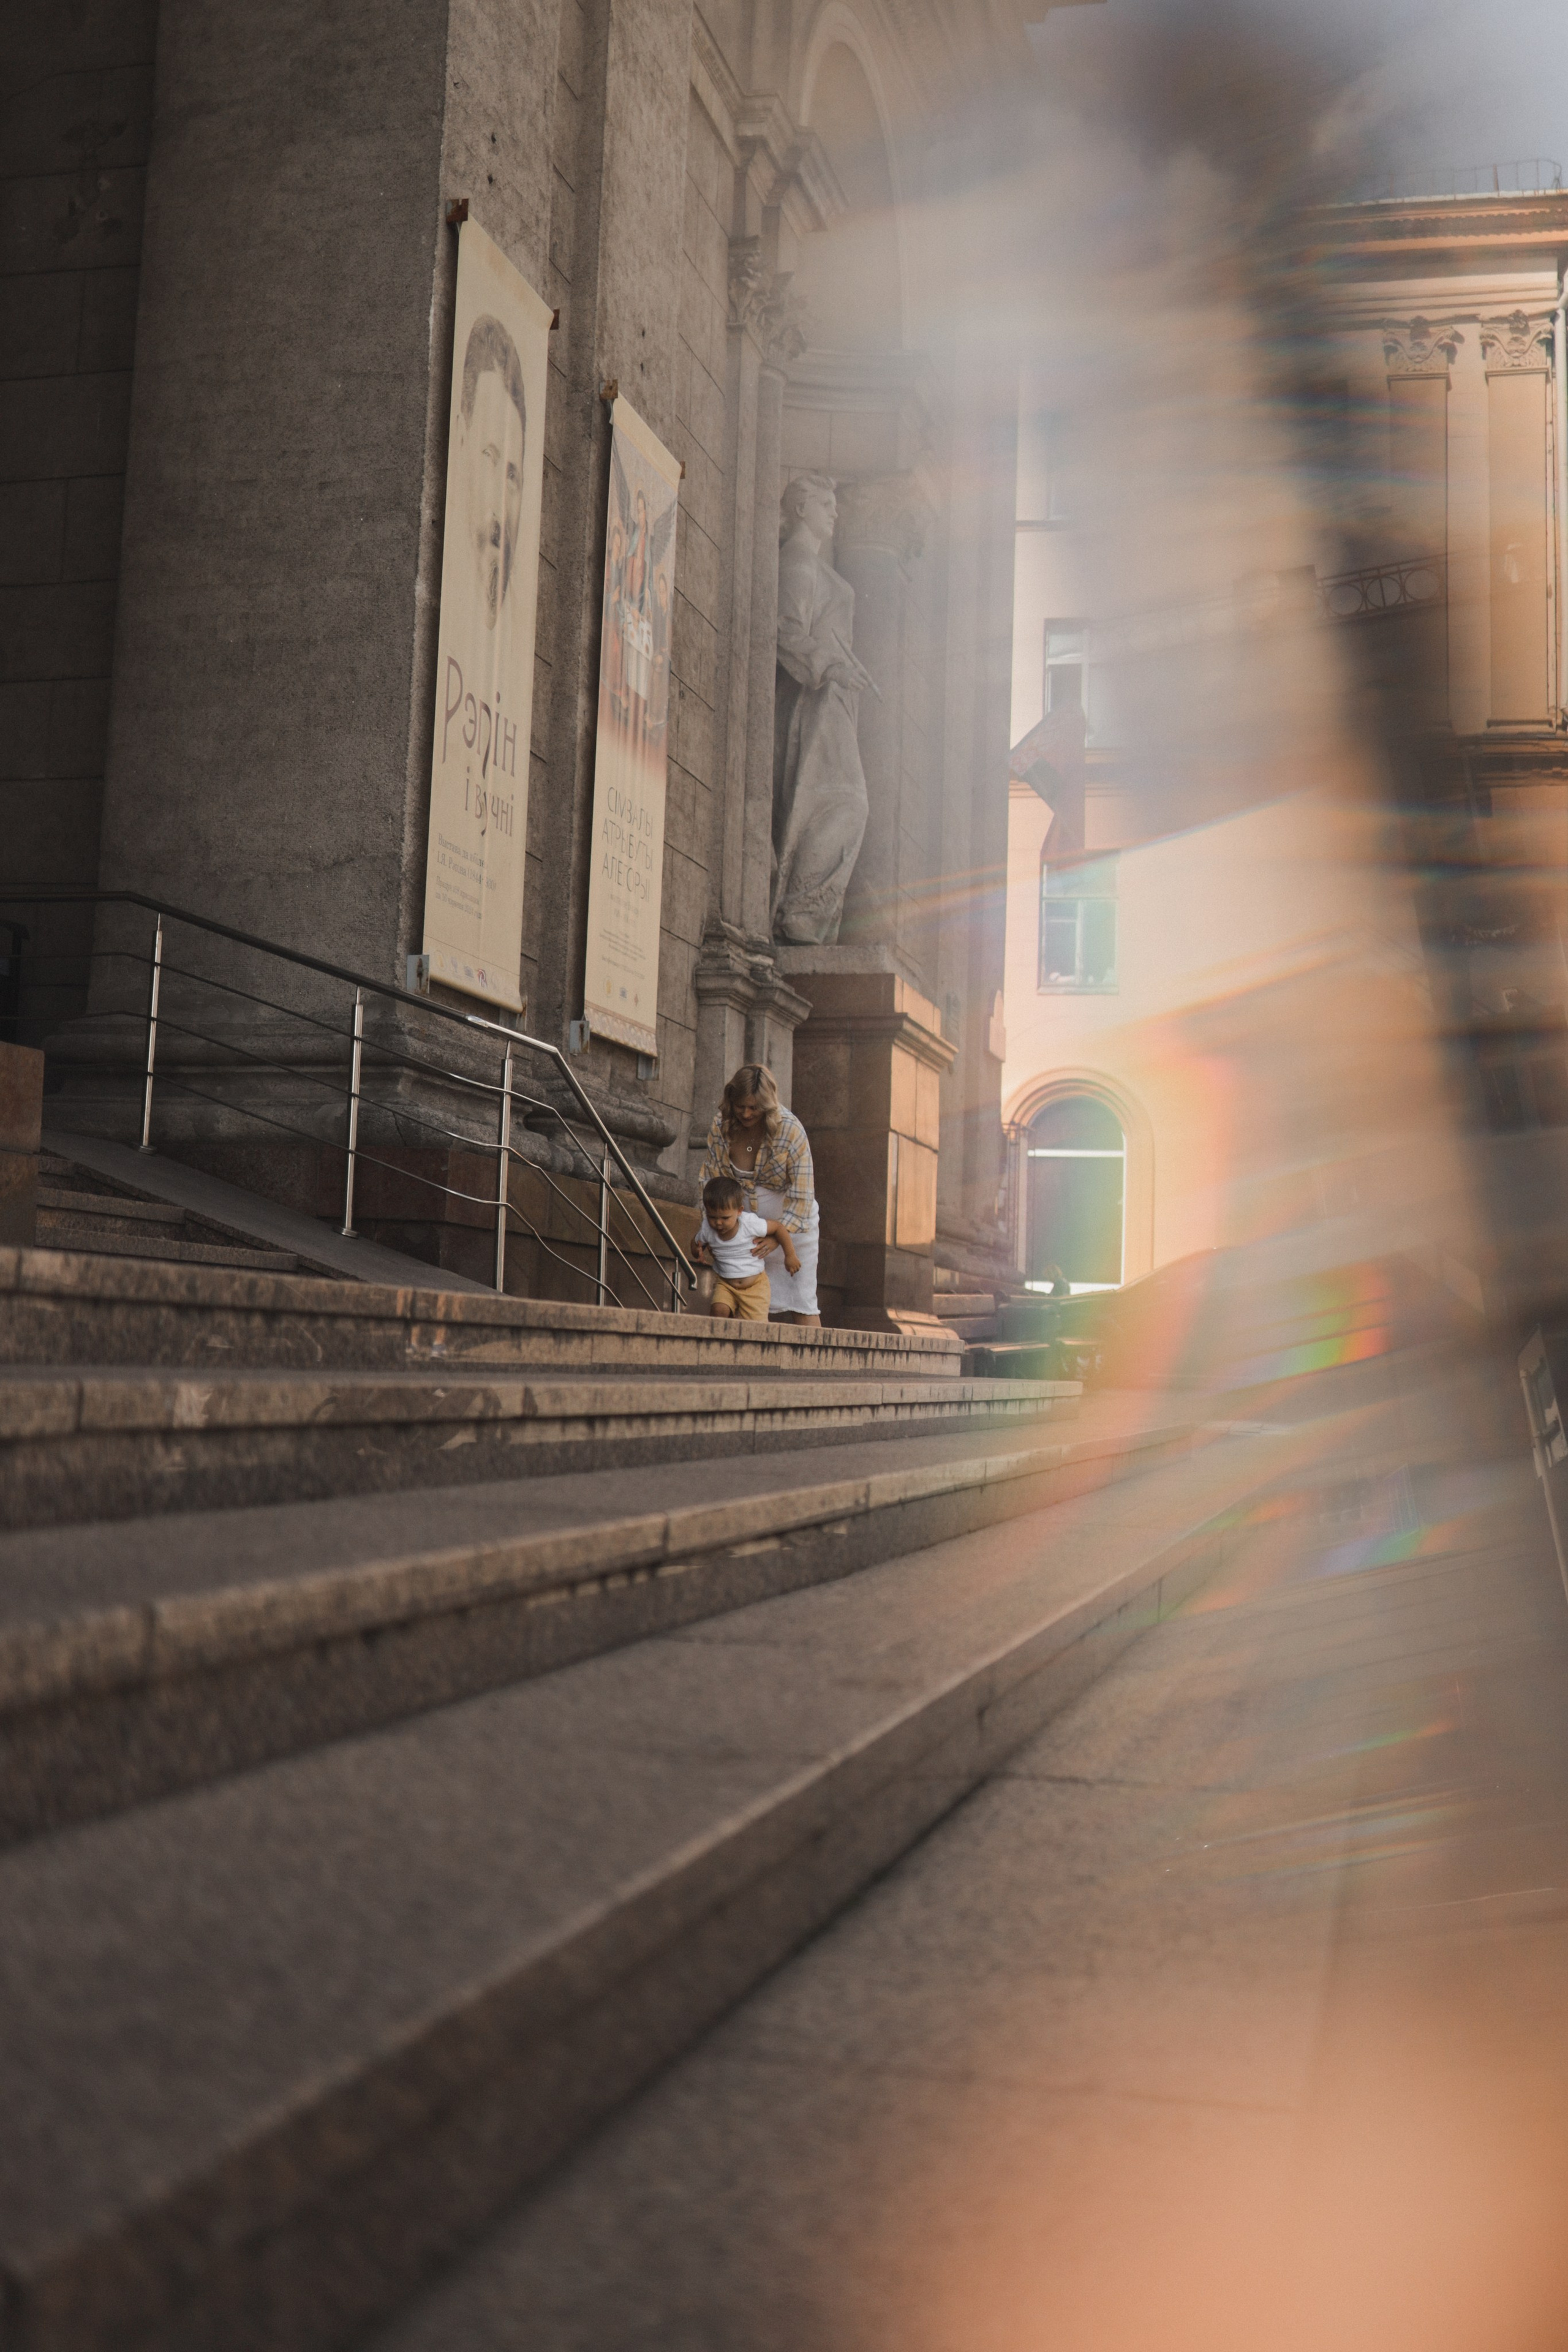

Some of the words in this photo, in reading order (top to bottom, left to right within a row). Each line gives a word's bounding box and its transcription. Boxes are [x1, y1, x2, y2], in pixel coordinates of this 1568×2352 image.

[442, 655, 517, 780] Рэпін
[465, 766, 470, 812] і
[475, 783, 513, 838] вучні
